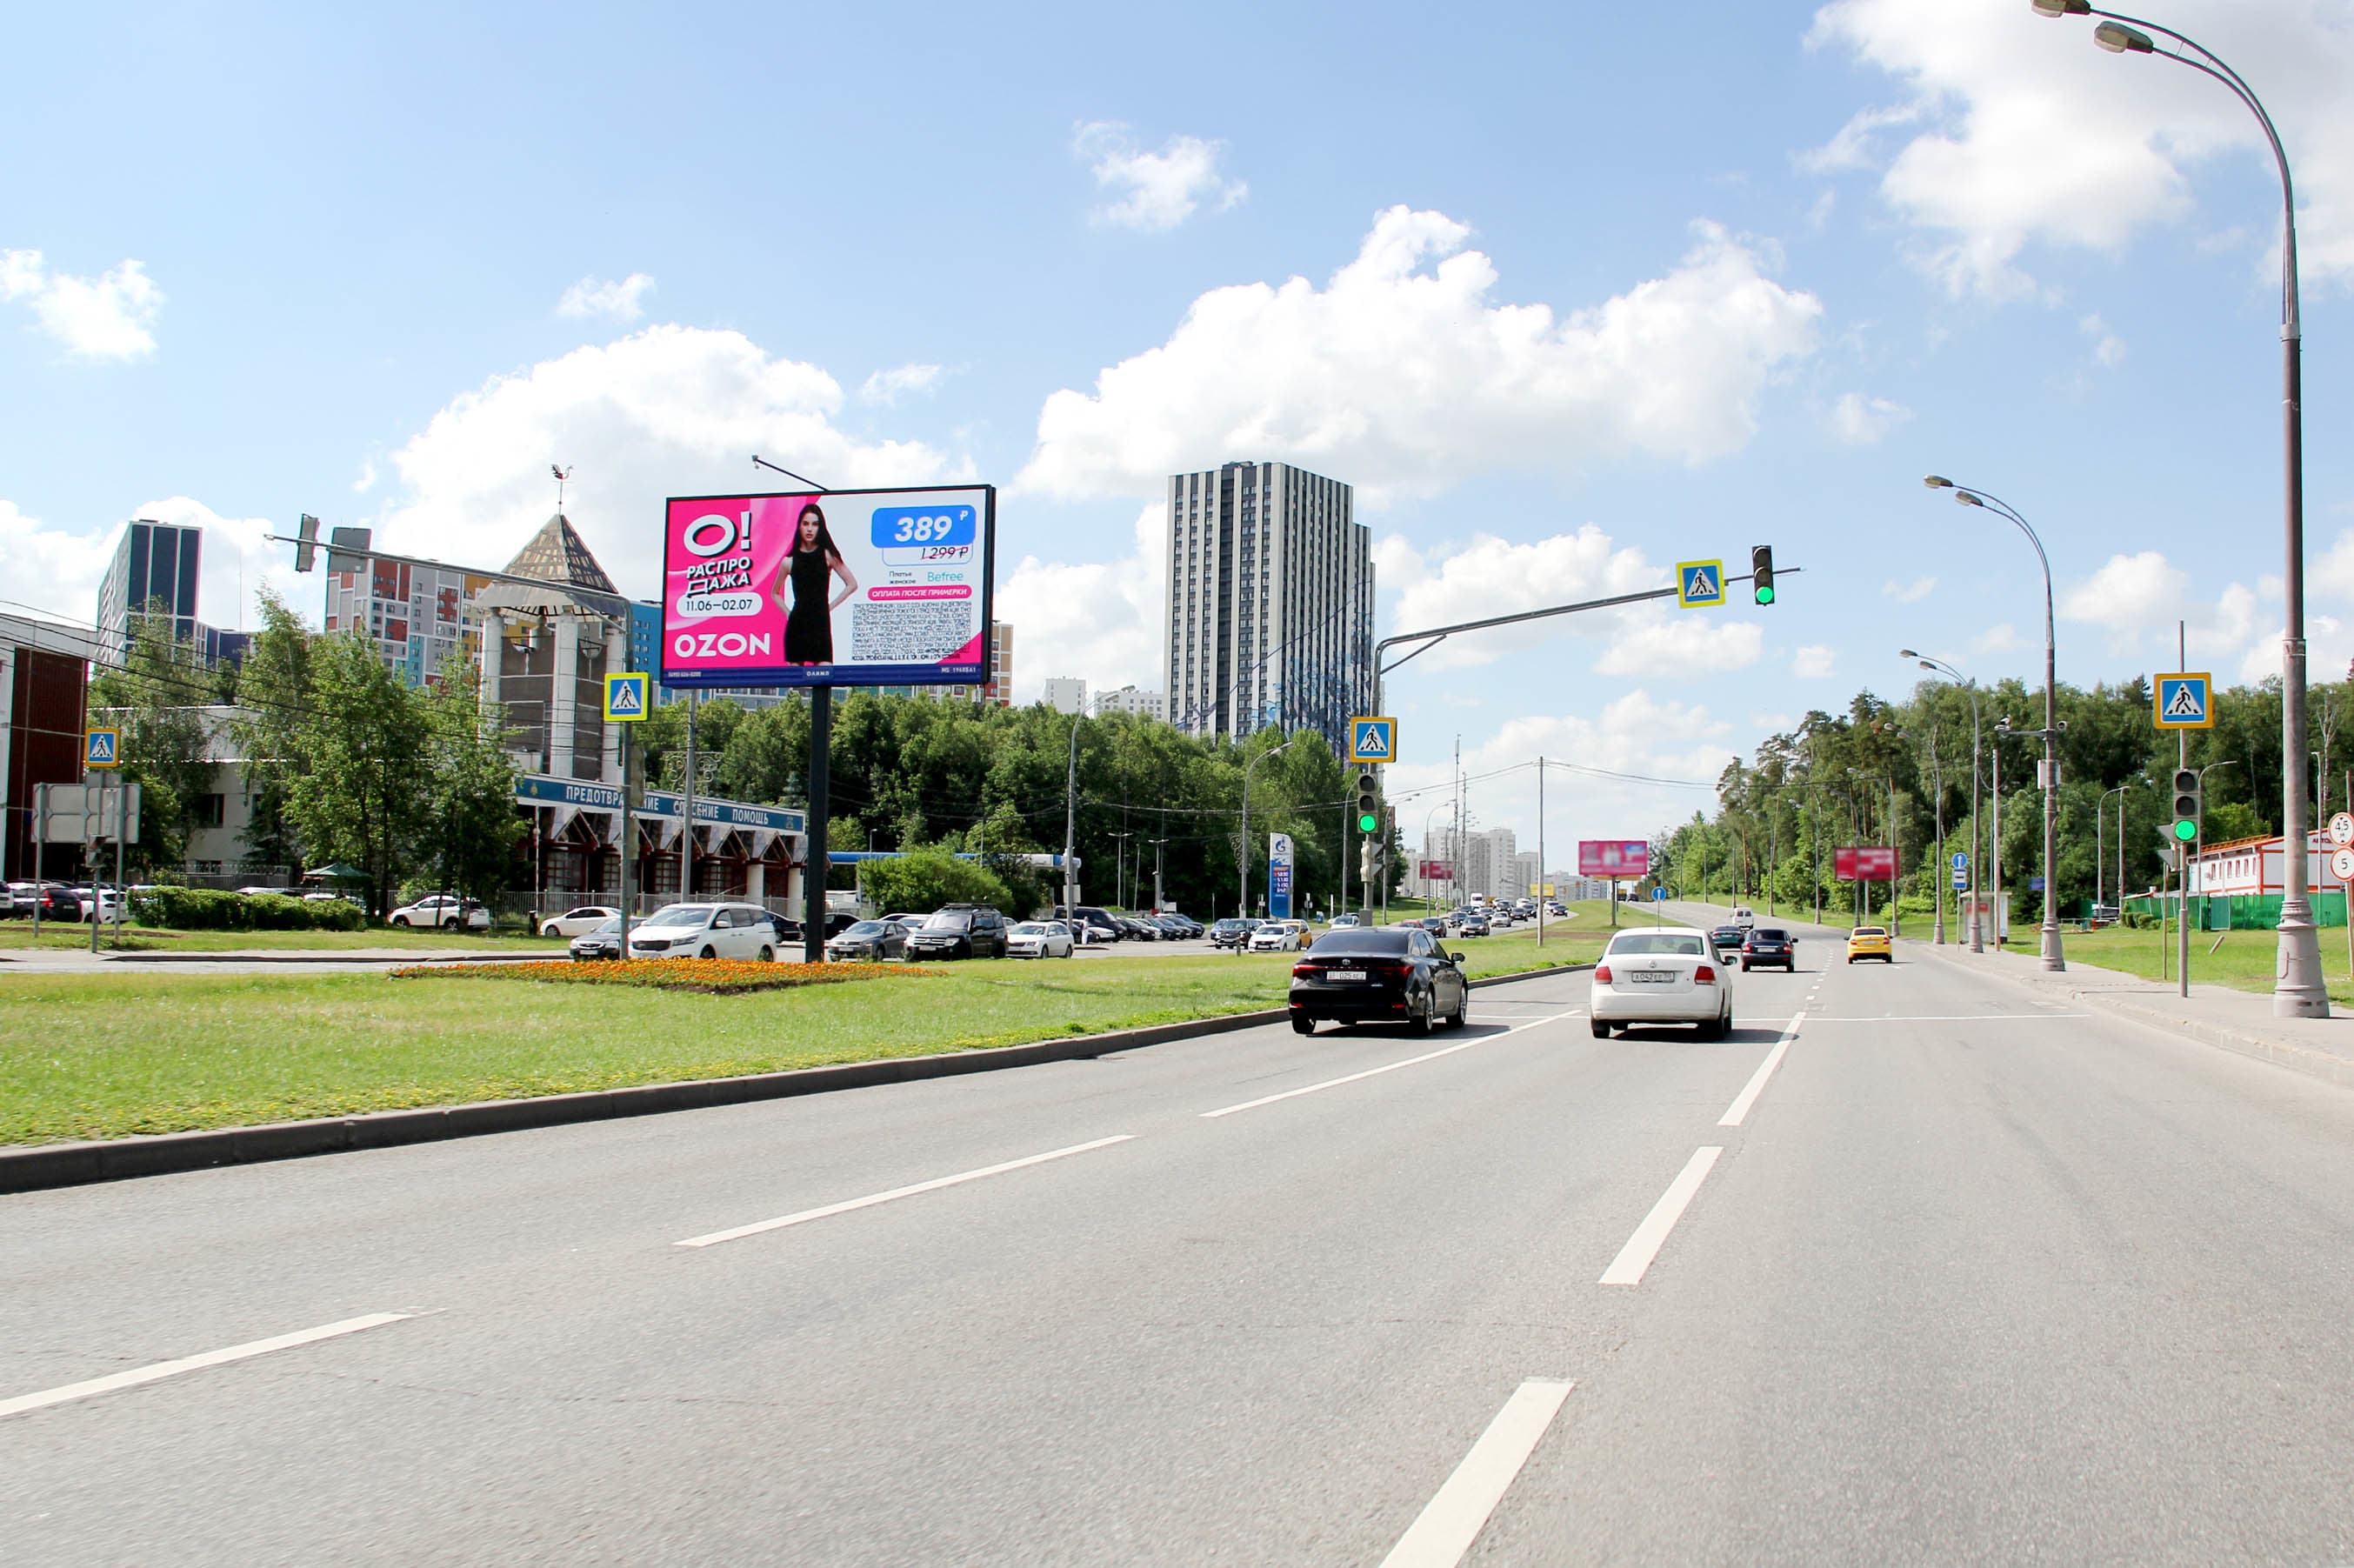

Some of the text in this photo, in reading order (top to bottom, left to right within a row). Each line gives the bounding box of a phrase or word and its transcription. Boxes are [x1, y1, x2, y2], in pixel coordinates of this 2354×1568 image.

[684, 510, 752, 557] О!
[894, 515, 953, 542] 389
[686, 557, 752, 579] РАСПРО
[927, 571, 964, 583] Befree
[685, 572, 752, 598] ДАЖА
[674, 632, 770, 658] OZON
[566, 785, 770, 824] ПРЕДОТВРАНИЕ СПСЕНИЕ ПОМОЩЬ
[2341, 858, 2348, 870] 5
